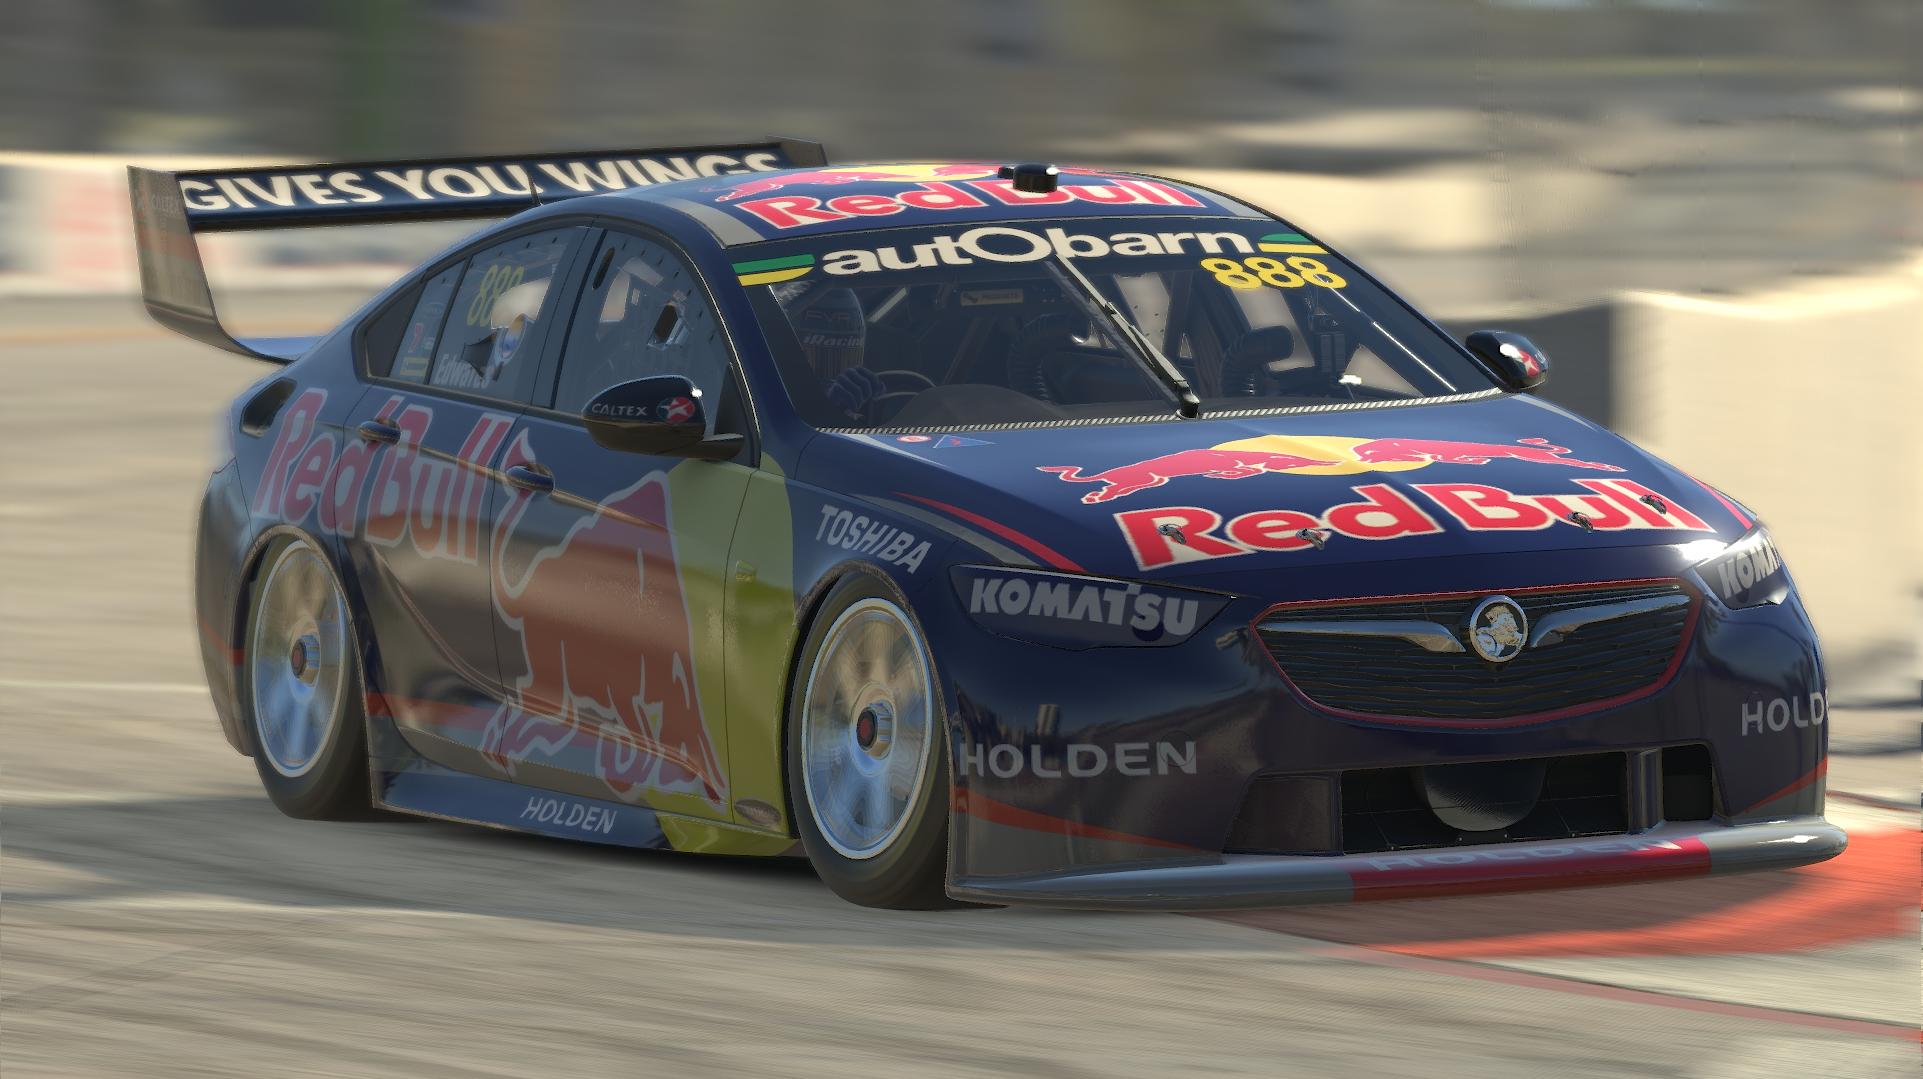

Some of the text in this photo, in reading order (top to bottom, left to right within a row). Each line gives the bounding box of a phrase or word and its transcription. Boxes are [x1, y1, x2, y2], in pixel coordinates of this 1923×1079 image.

[179, 171, 384, 210] GIVES
[374, 165, 544, 200] YOU
[733, 178, 1208, 230] Red Bull
[1200, 257, 1347, 289] 888
[591, 403, 648, 417] CALTEX
[251, 388, 516, 567] Red Bull
[816, 504, 932, 574] TOSHIBA
[1114, 477, 1719, 572] Red Bull
[970, 577, 1199, 636] KOMATSU
[1741, 690, 1829, 736] HOLD
[960, 741, 1198, 778] HOLDEN
[520, 796, 617, 834] HOLDEN
